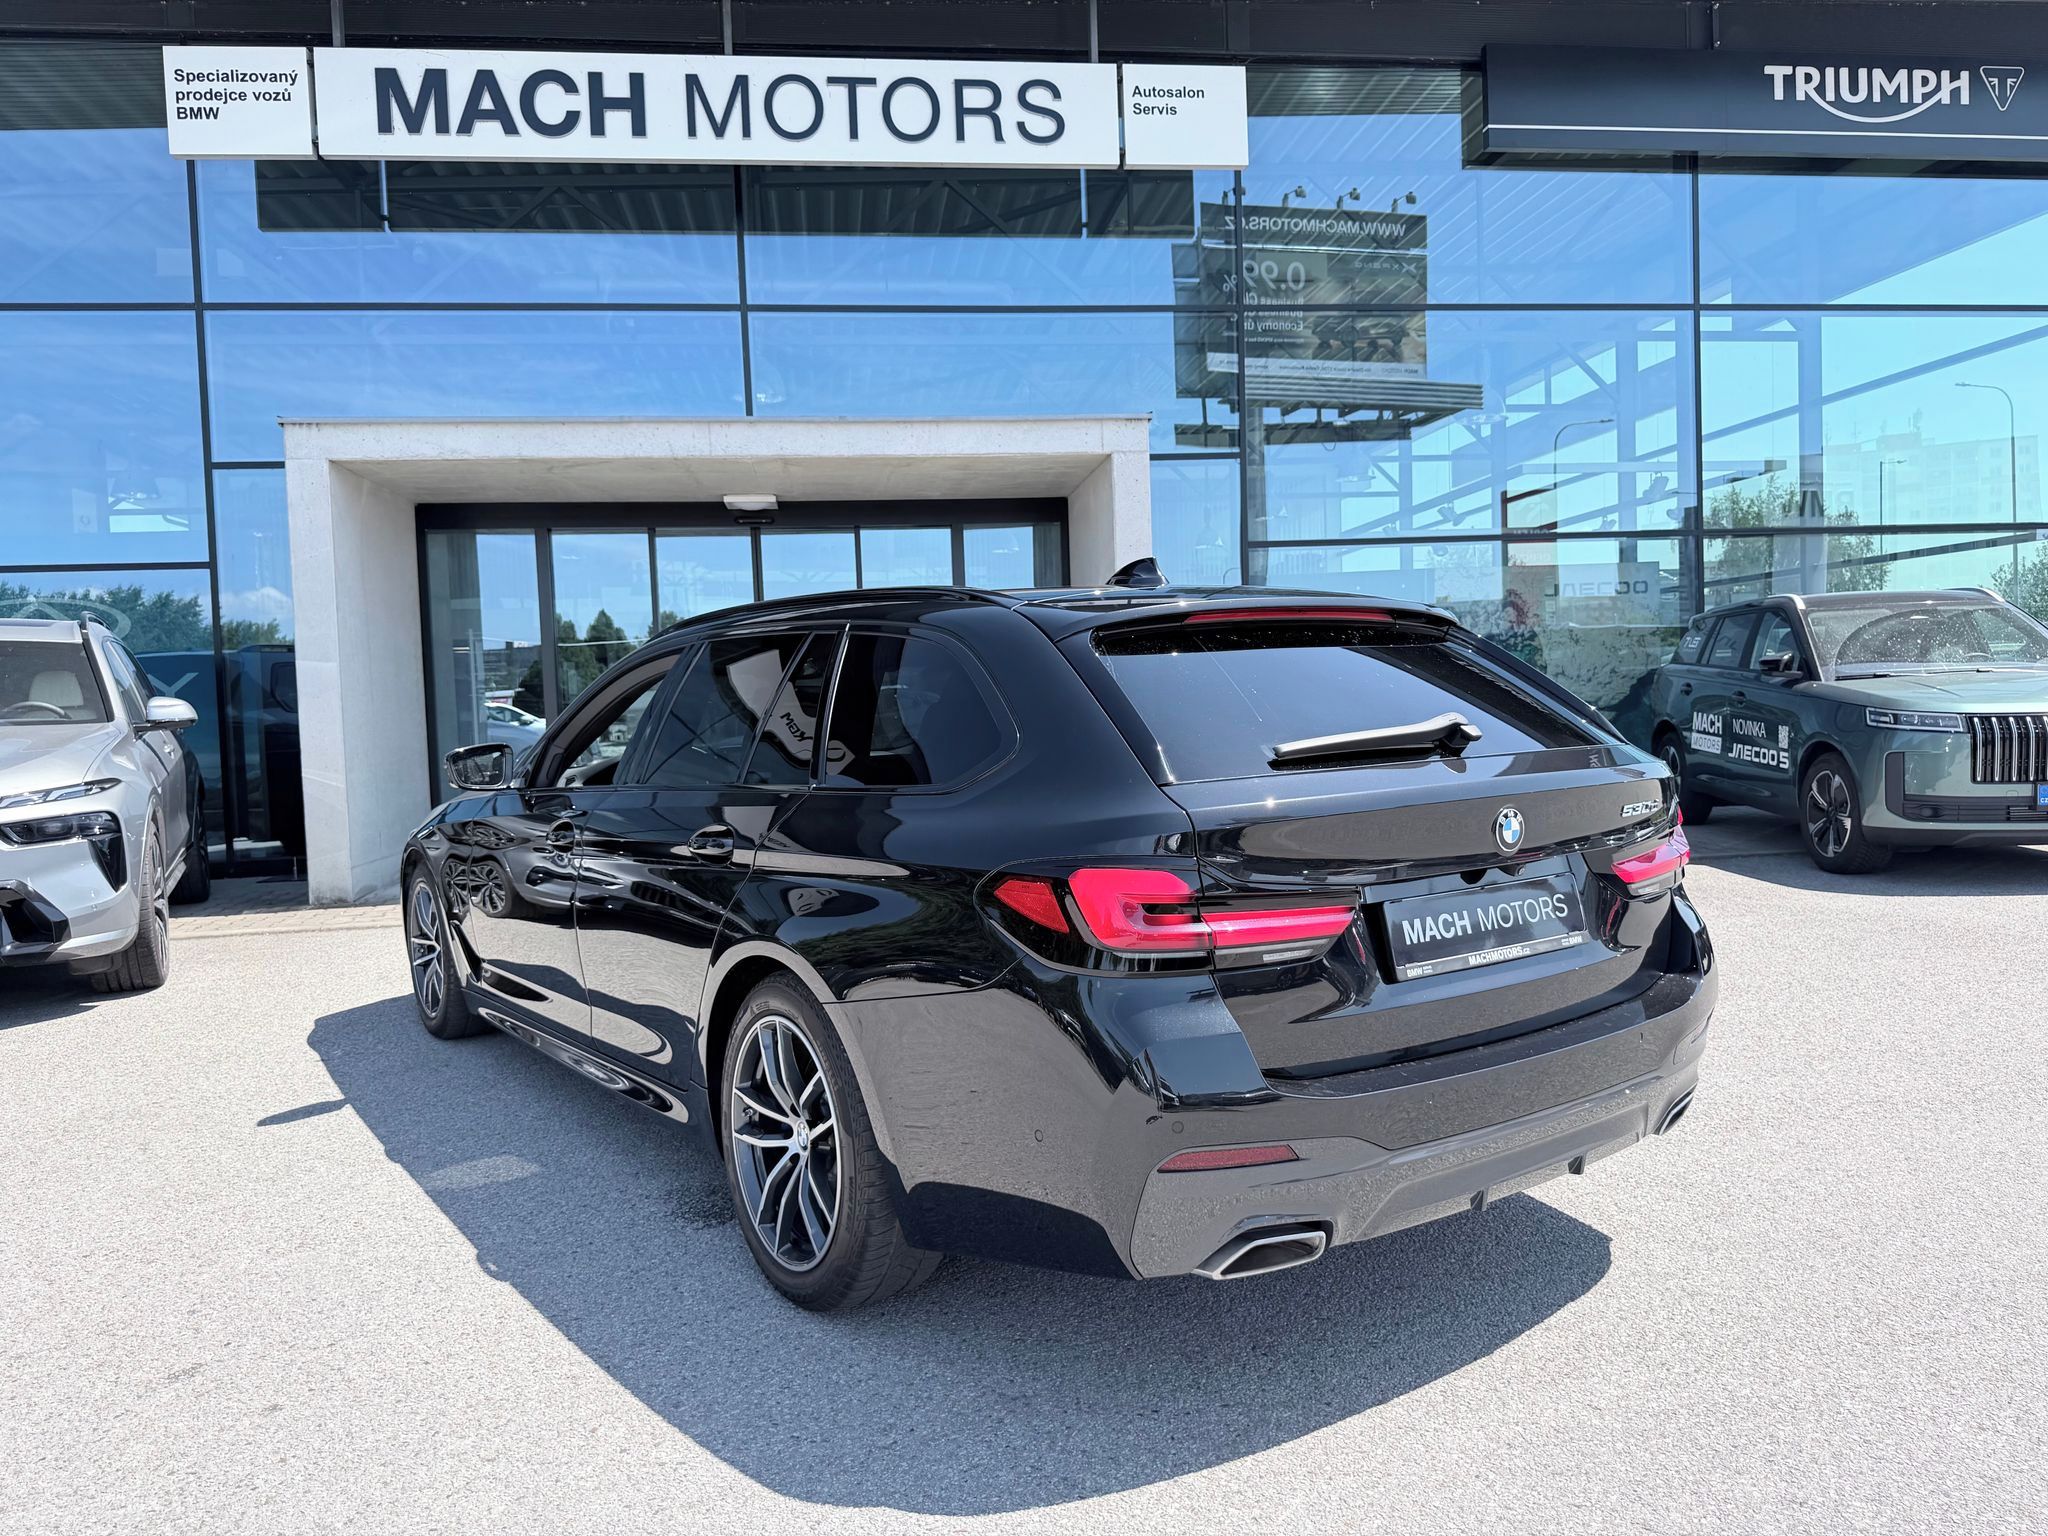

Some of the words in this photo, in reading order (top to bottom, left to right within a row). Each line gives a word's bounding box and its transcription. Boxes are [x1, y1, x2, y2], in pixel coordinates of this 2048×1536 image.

[173, 68, 299, 87] Specializovaný
[175, 88, 247, 105] prodejce
[252, 88, 292, 103] vozů
[1131, 85, 1205, 100] Autosalon
[1763, 65, 1970, 123] TRIUMPH
[176, 106, 220, 120] BMW
[374, 66, 648, 138] MACH
[684, 72, 1066, 145] MOTORS
[1132, 102, 1178, 117] Servis
[1692, 711, 1722, 735] MACH
[1732, 718, 1767, 738] NOVINKA
[1692, 735, 1721, 752] MOTORS
[1728, 742, 1778, 766] JAECOO
[1779, 751, 1789, 769] 5
[1401, 910, 1473, 946] MACH
[1476, 893, 1569, 932] MOTORS
[1406, 967, 1423, 978] BMW
